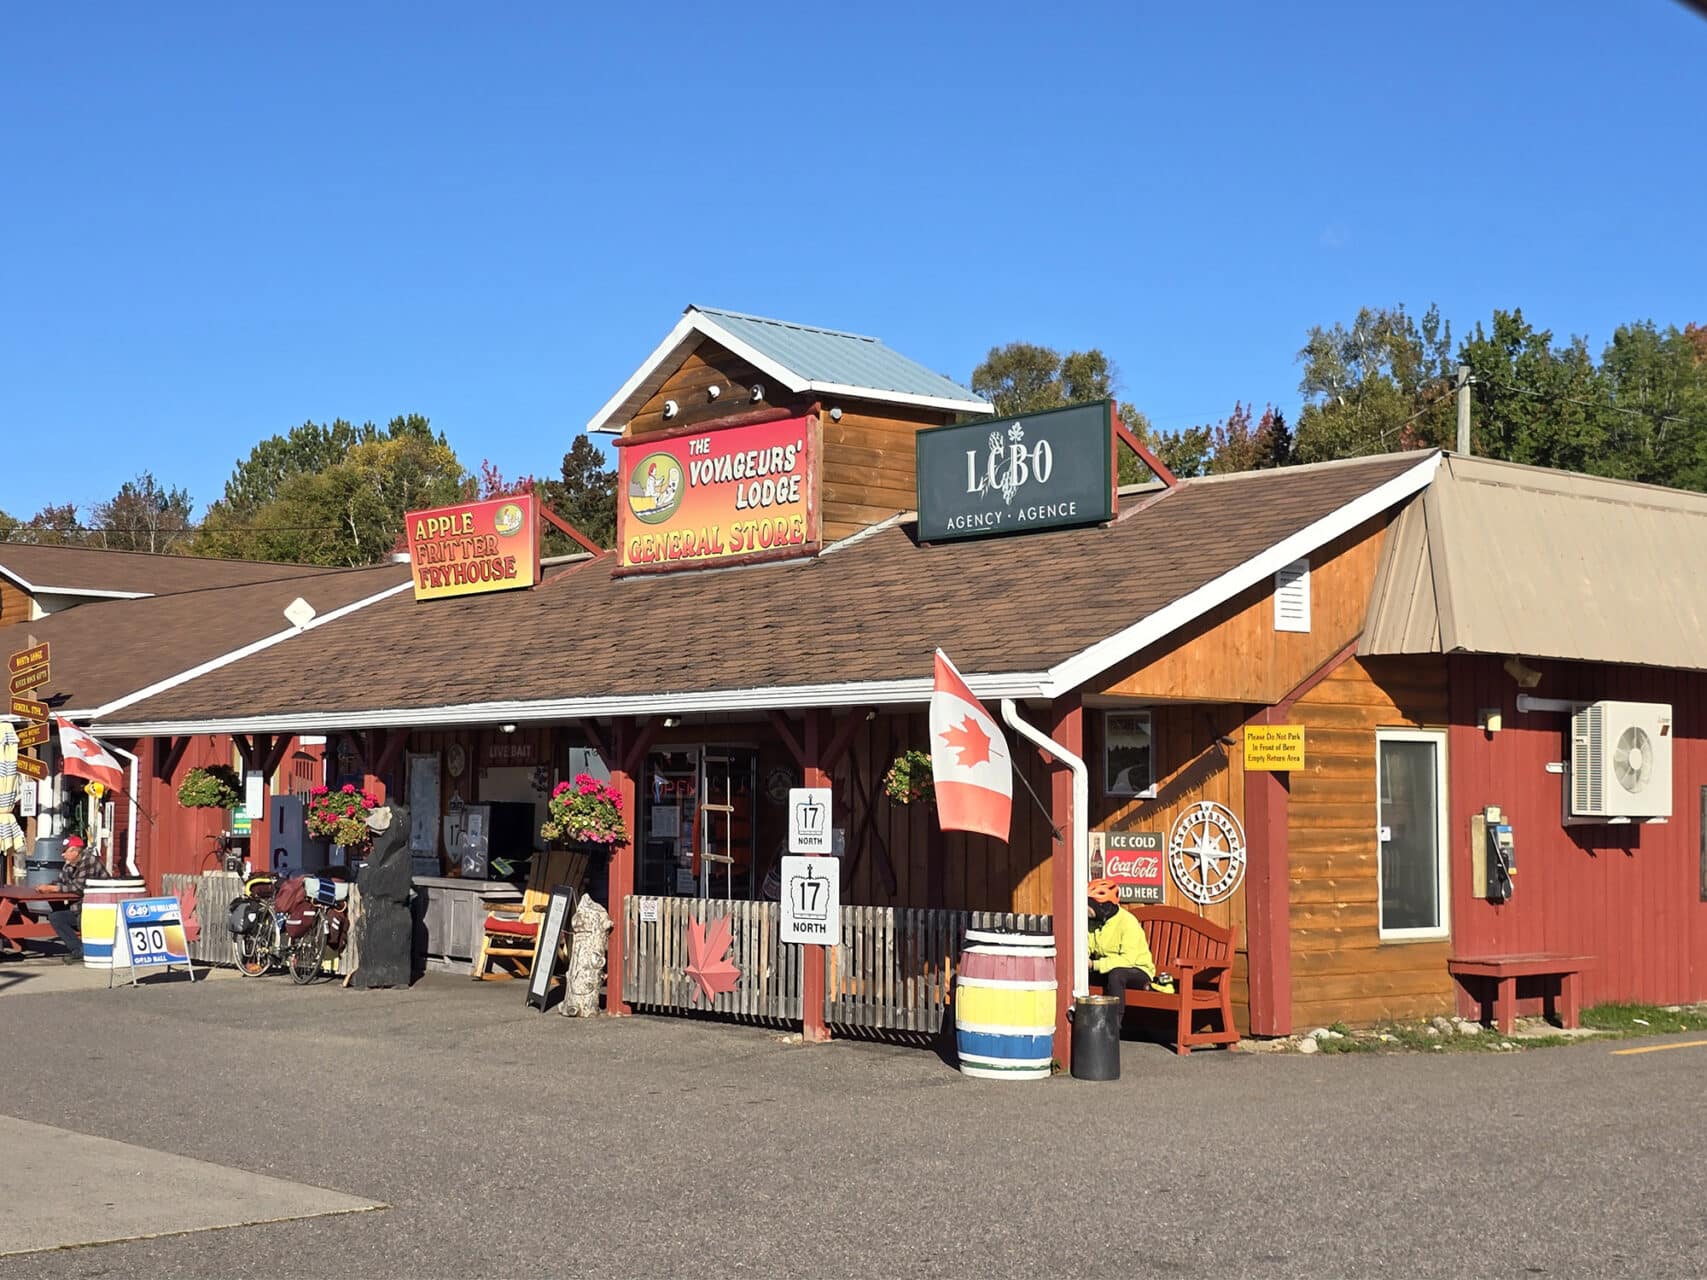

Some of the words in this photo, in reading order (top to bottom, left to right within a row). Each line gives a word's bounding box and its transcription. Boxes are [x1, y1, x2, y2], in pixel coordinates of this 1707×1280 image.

[688, 437, 711, 455] THE
[689, 439, 803, 487] VOYAGEURS'
[966, 439, 1053, 493] LCBO
[735, 474, 802, 510] LODGE
[415, 511, 475, 541] APPLE
[947, 511, 1002, 530] AGENCY
[1018, 502, 1077, 521] AGENCE
[416, 534, 499, 565] FRITTER
[628, 525, 724, 564] GENERAL
[729, 513, 804, 552] STORE
[419, 556, 517, 589] FRYHOUSE
[1266, 732, 1275, 740] Do
[1276, 732, 1286, 740] Not
[1288, 732, 1301, 740] Park
[489, 744, 509, 758] LIVE
[511, 744, 531, 758] BAIT
[1248, 754, 1265, 763] Empty
[1266, 753, 1285, 762] Return
[1287, 754, 1300, 762] Area
[802, 806, 819, 829] 17
[798, 837, 823, 846] NORTH
[1111, 836, 1126, 847] ICE
[1129, 836, 1156, 848] COLD
[1107, 856, 1158, 878] Coca-Cola
[799, 882, 821, 911] 17
[1118, 887, 1133, 897] LD
[1135, 887, 1159, 899] HERE
[128, 903, 148, 917] 649
[792, 921, 827, 934] NORTH
